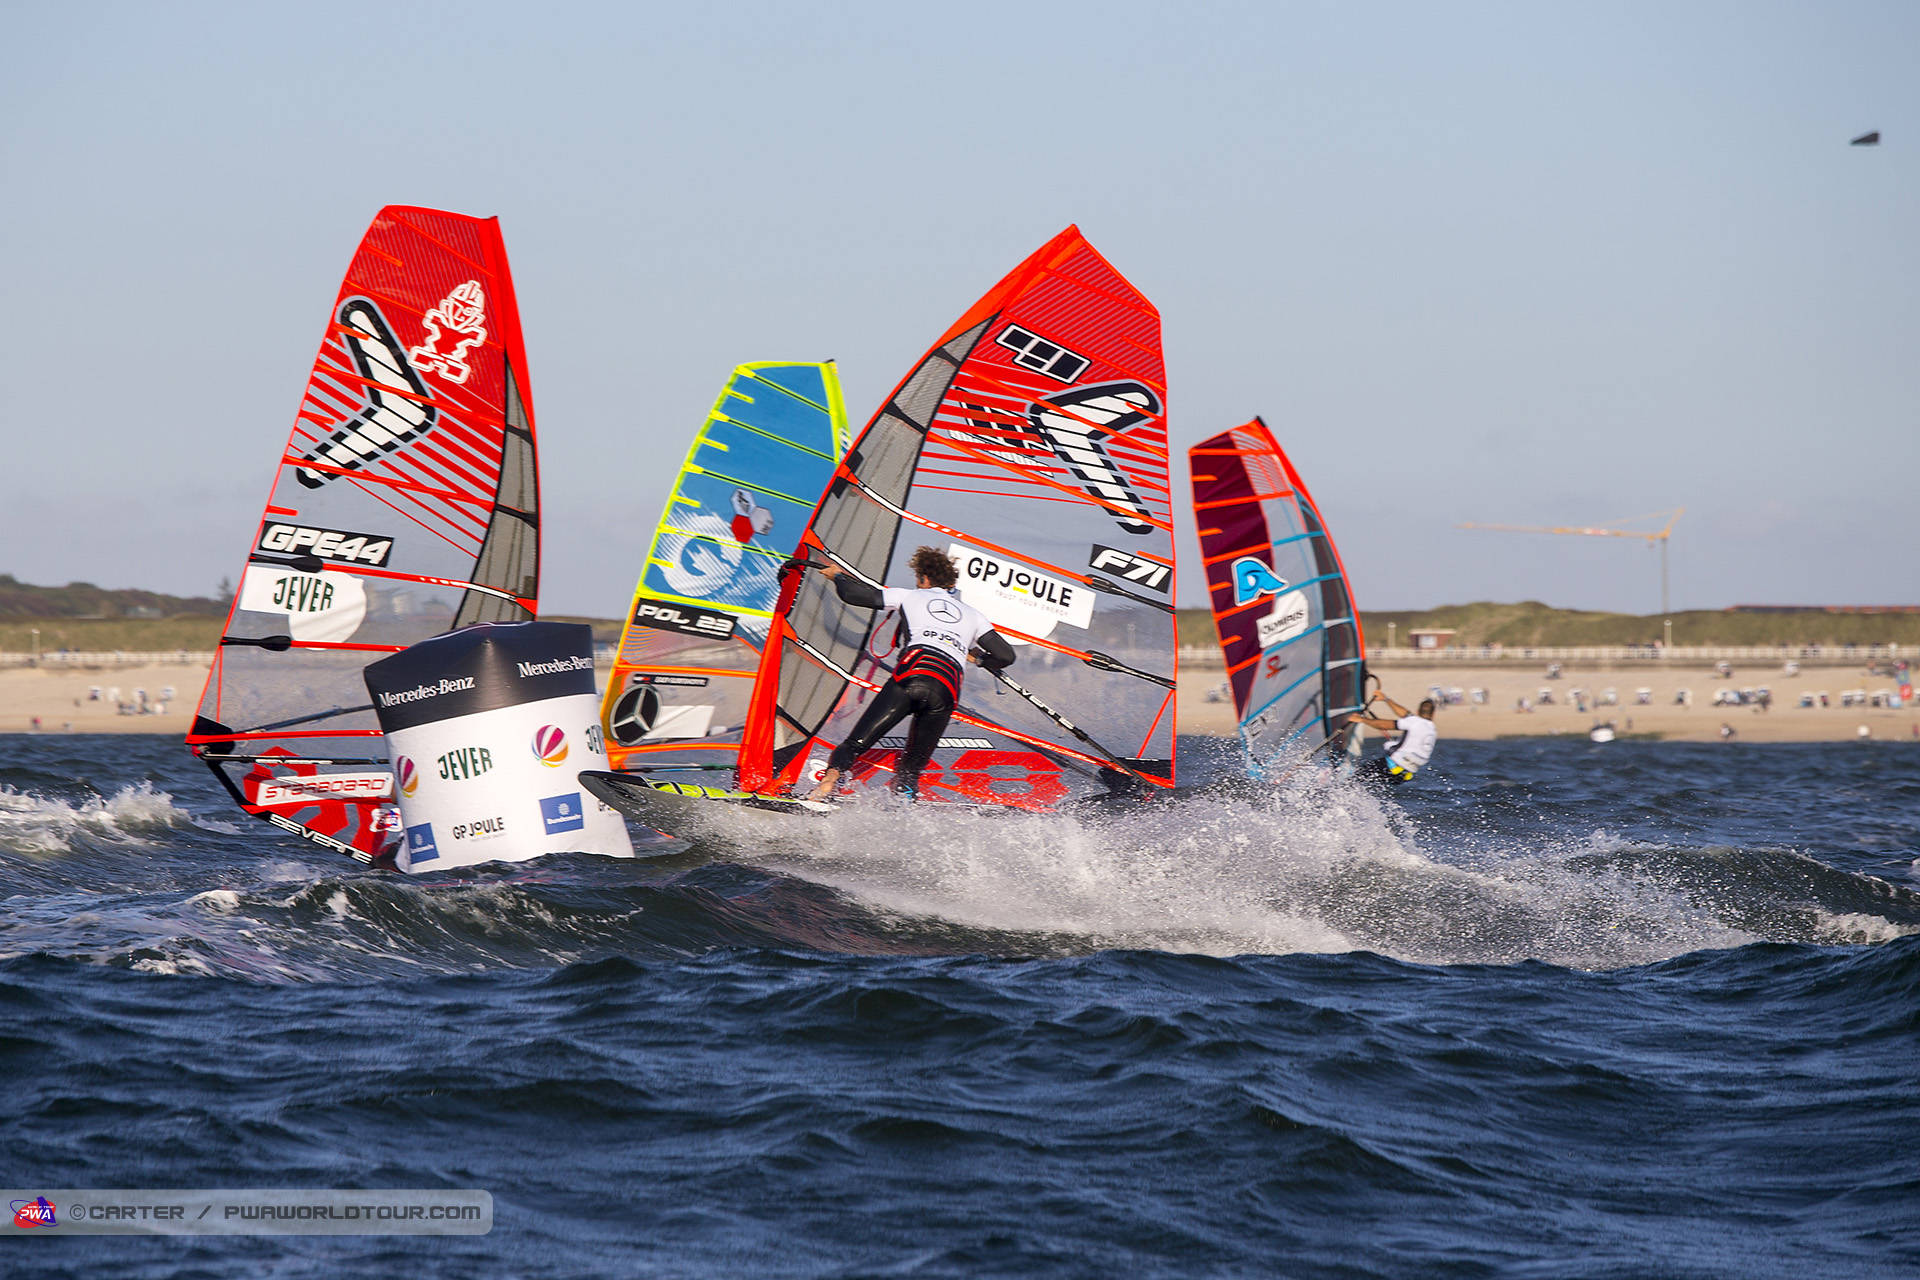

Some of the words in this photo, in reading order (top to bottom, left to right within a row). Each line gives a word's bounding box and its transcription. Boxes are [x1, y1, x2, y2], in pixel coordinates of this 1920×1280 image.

[261, 524, 392, 564] GPE44
[967, 557, 999, 581] GP
[999, 568, 1073, 607] JOULE
[1091, 549, 1170, 588] F71
[273, 576, 334, 612] JEVER
[637, 604, 690, 624] POL
[695, 615, 734, 633] 23
[923, 630, 938, 638] GP
[378, 676, 475, 708] Mercedes-Benz
[437, 747, 493, 780] JEVER
[265, 779, 386, 798] STARBOARD
[453, 825, 467, 840] GP
[468, 817, 505, 836] JOULE
